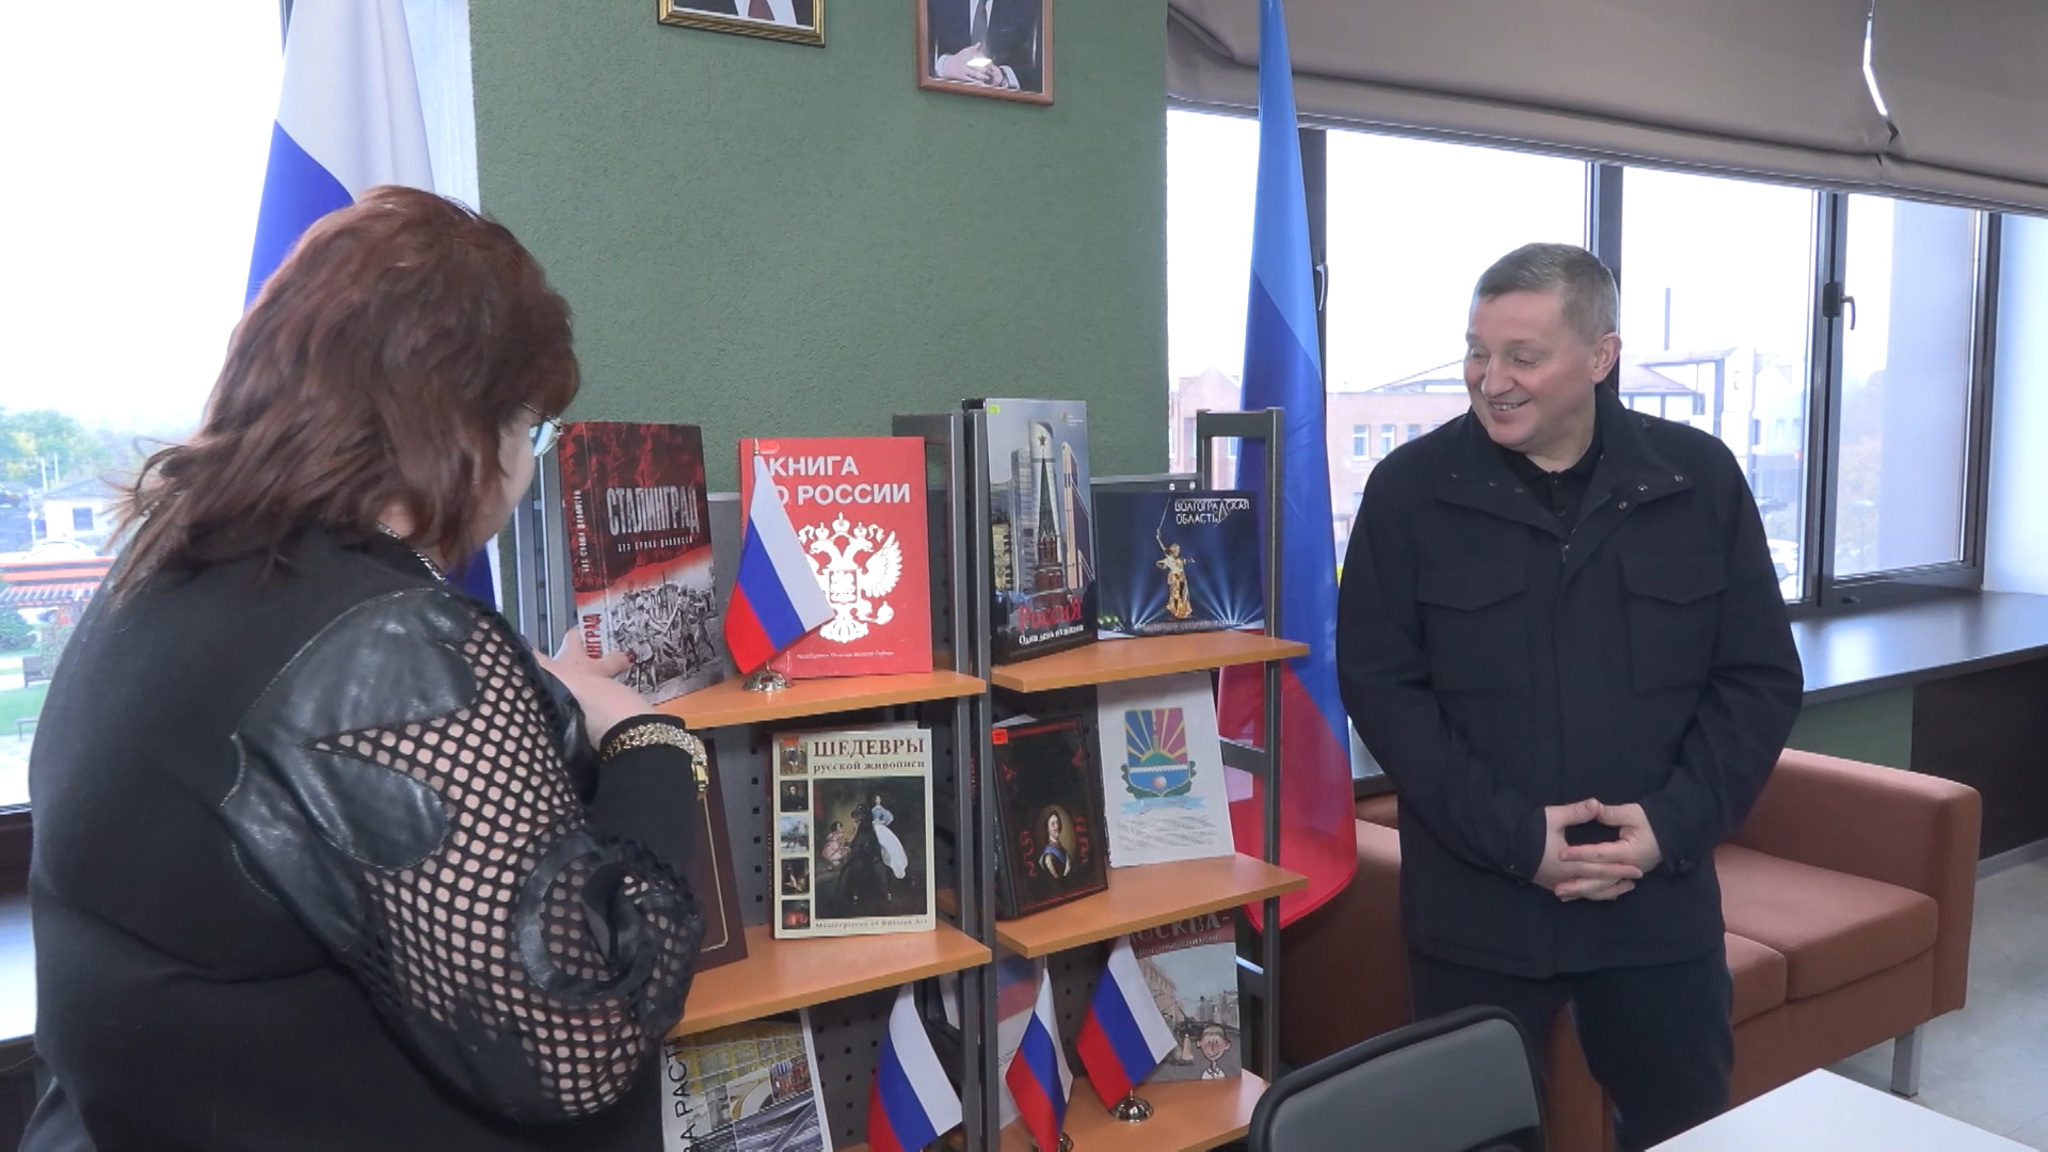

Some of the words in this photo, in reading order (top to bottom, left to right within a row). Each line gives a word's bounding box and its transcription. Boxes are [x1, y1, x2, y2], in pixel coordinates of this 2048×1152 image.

[769, 455, 860, 477] КНИГА
[797, 483, 911, 505] РОССИИ
[606, 485, 701, 536] СТАЛИНГРАД
[1174, 498, 1250, 524] ВОЛГОГРАДСКАЯ
[1175, 513, 1219, 525] ОБЛАСТЬ
[812, 737, 925, 759] ШЕДЕВРЫ
[813, 761, 861, 776] русской
[864, 761, 925, 772] живописи
